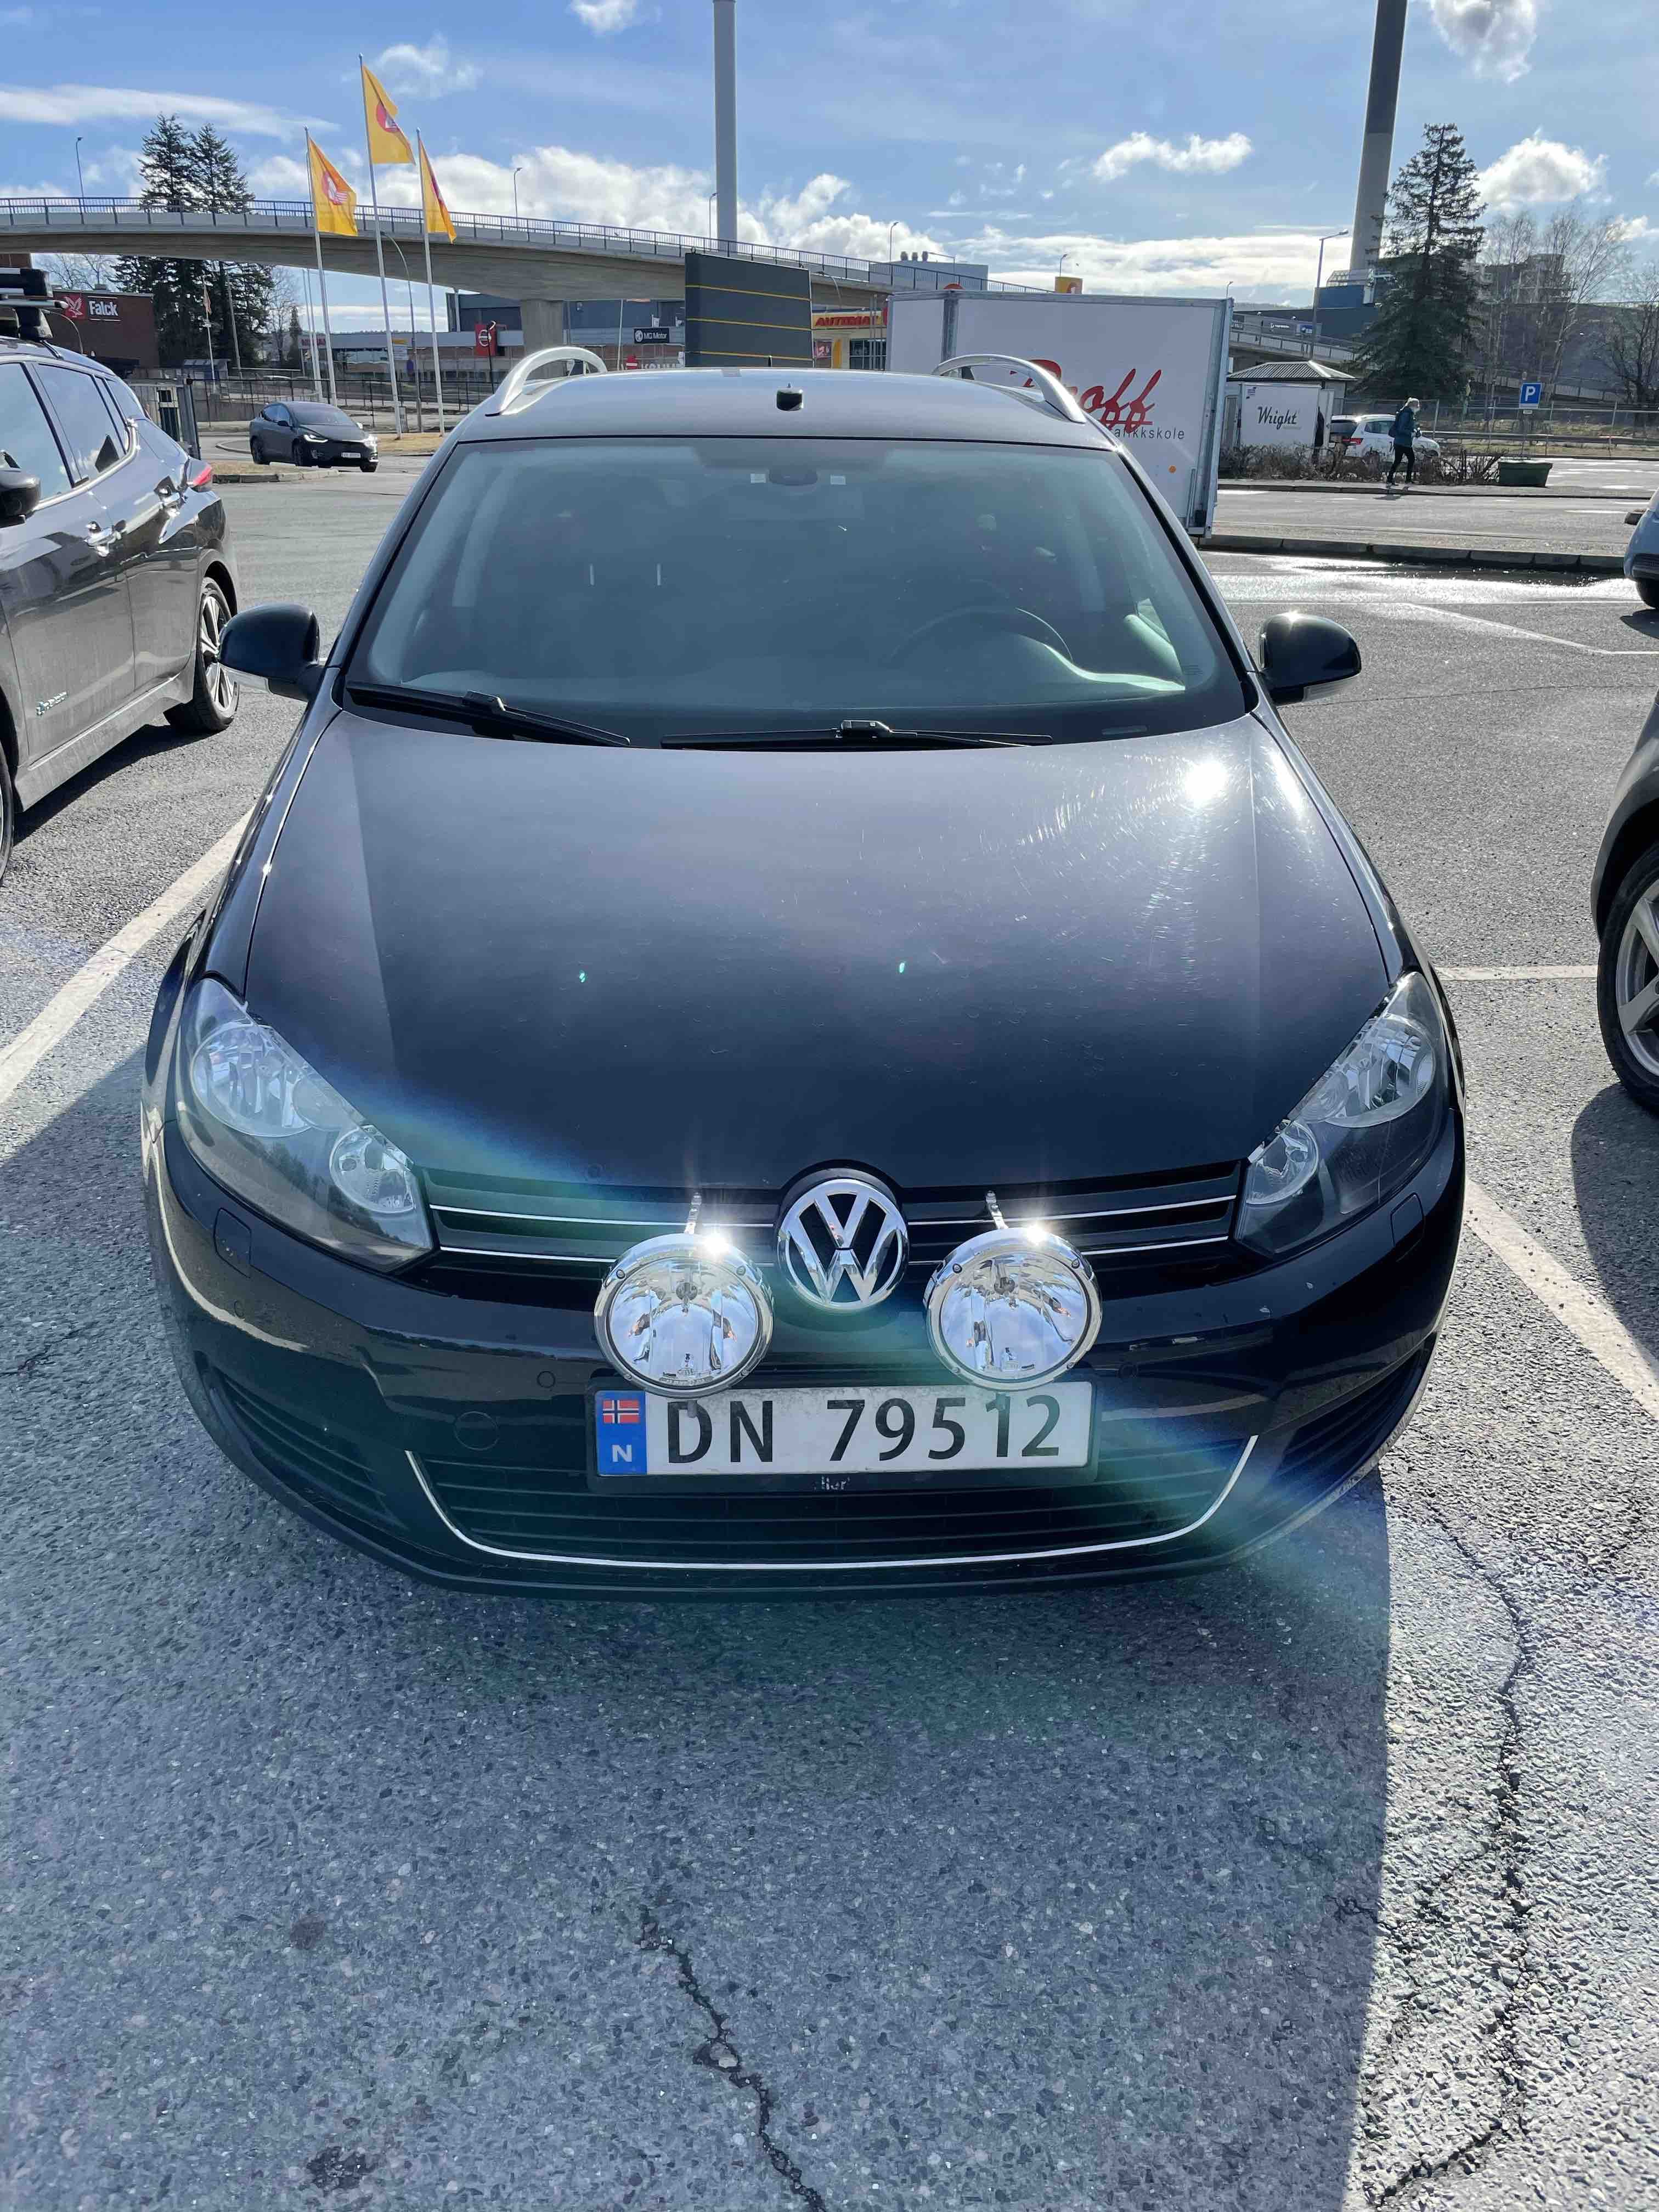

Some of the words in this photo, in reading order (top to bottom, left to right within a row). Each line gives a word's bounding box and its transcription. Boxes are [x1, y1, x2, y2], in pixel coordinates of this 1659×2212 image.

[89, 300, 119, 316] Falck
[1525, 386, 1536, 401] P
[1258, 406, 1297, 430] Wright
[777, 1179, 909, 1308] VW
[667, 1400, 773, 1464] DN
[827, 1393, 1060, 1462] 79512
[612, 1444, 633, 1462] N
